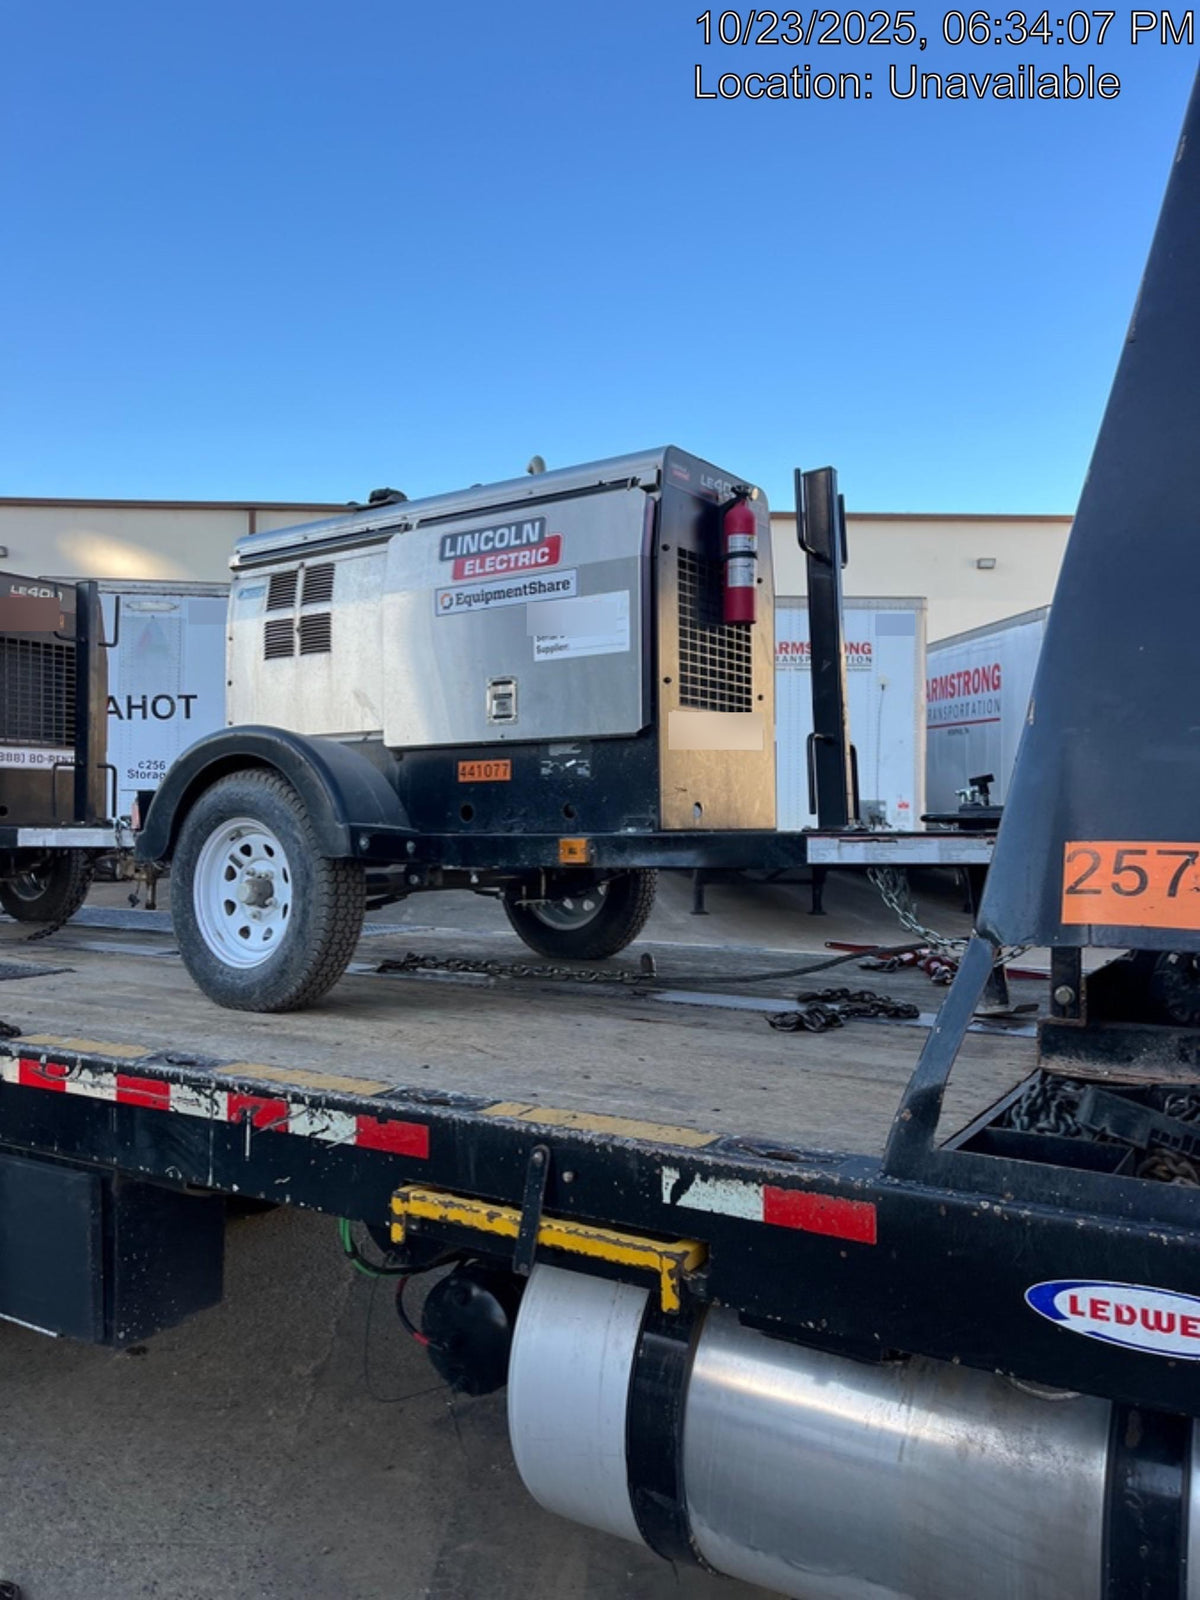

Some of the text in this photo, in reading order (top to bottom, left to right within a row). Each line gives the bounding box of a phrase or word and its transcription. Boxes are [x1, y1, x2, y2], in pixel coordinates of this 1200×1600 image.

[443, 521, 541, 558] LINCOLN
[463, 547, 550, 576] ELECTRIC
[454, 578, 571, 606] EquipmentShare
[927, 698, 1001, 721] RANSPORTATION
[127, 768, 166, 781] Storag
[459, 763, 509, 779] 441077
[1068, 1294, 1200, 1338] LEDWE
